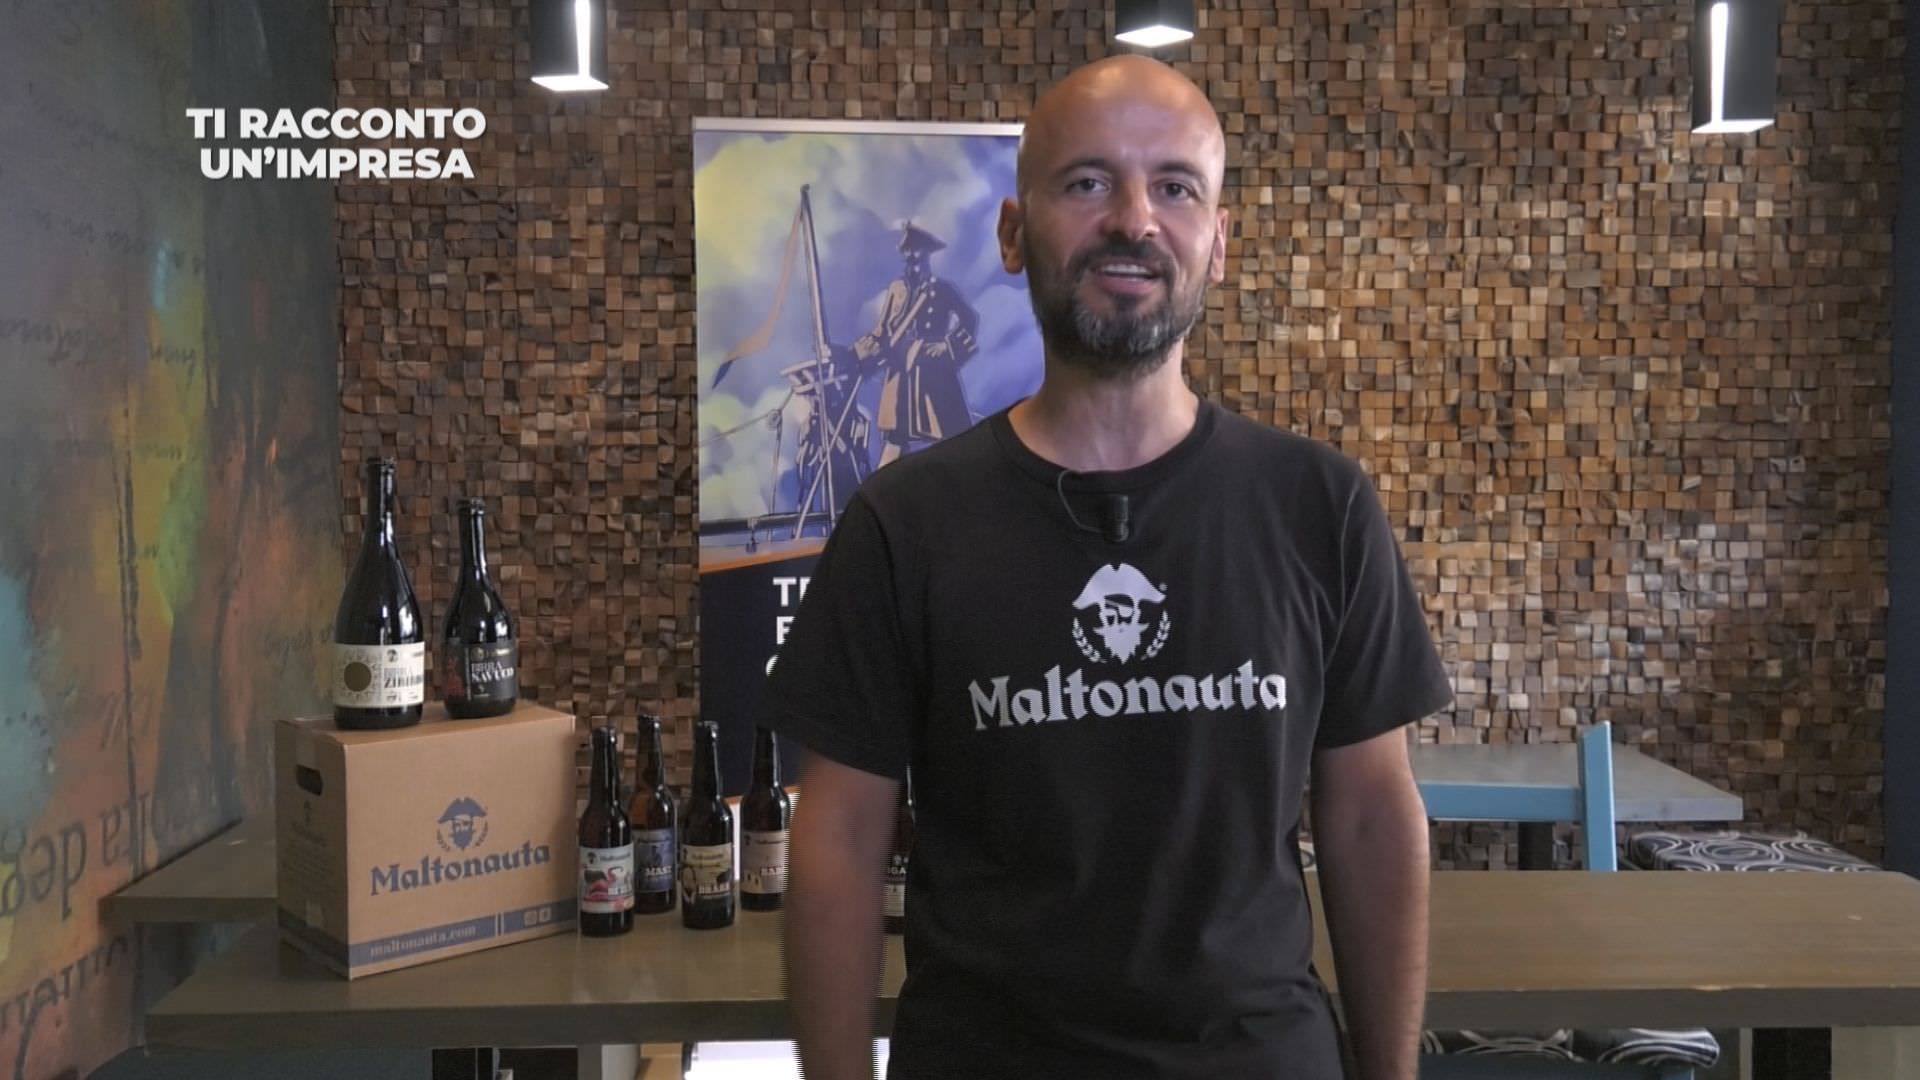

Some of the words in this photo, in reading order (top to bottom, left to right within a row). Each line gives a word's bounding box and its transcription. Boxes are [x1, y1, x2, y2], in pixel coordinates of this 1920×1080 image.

[967, 659, 1287, 731] Maltonauta
[370, 840, 550, 896] Maltonauta
[370, 925, 476, 957] maltonauta.com
